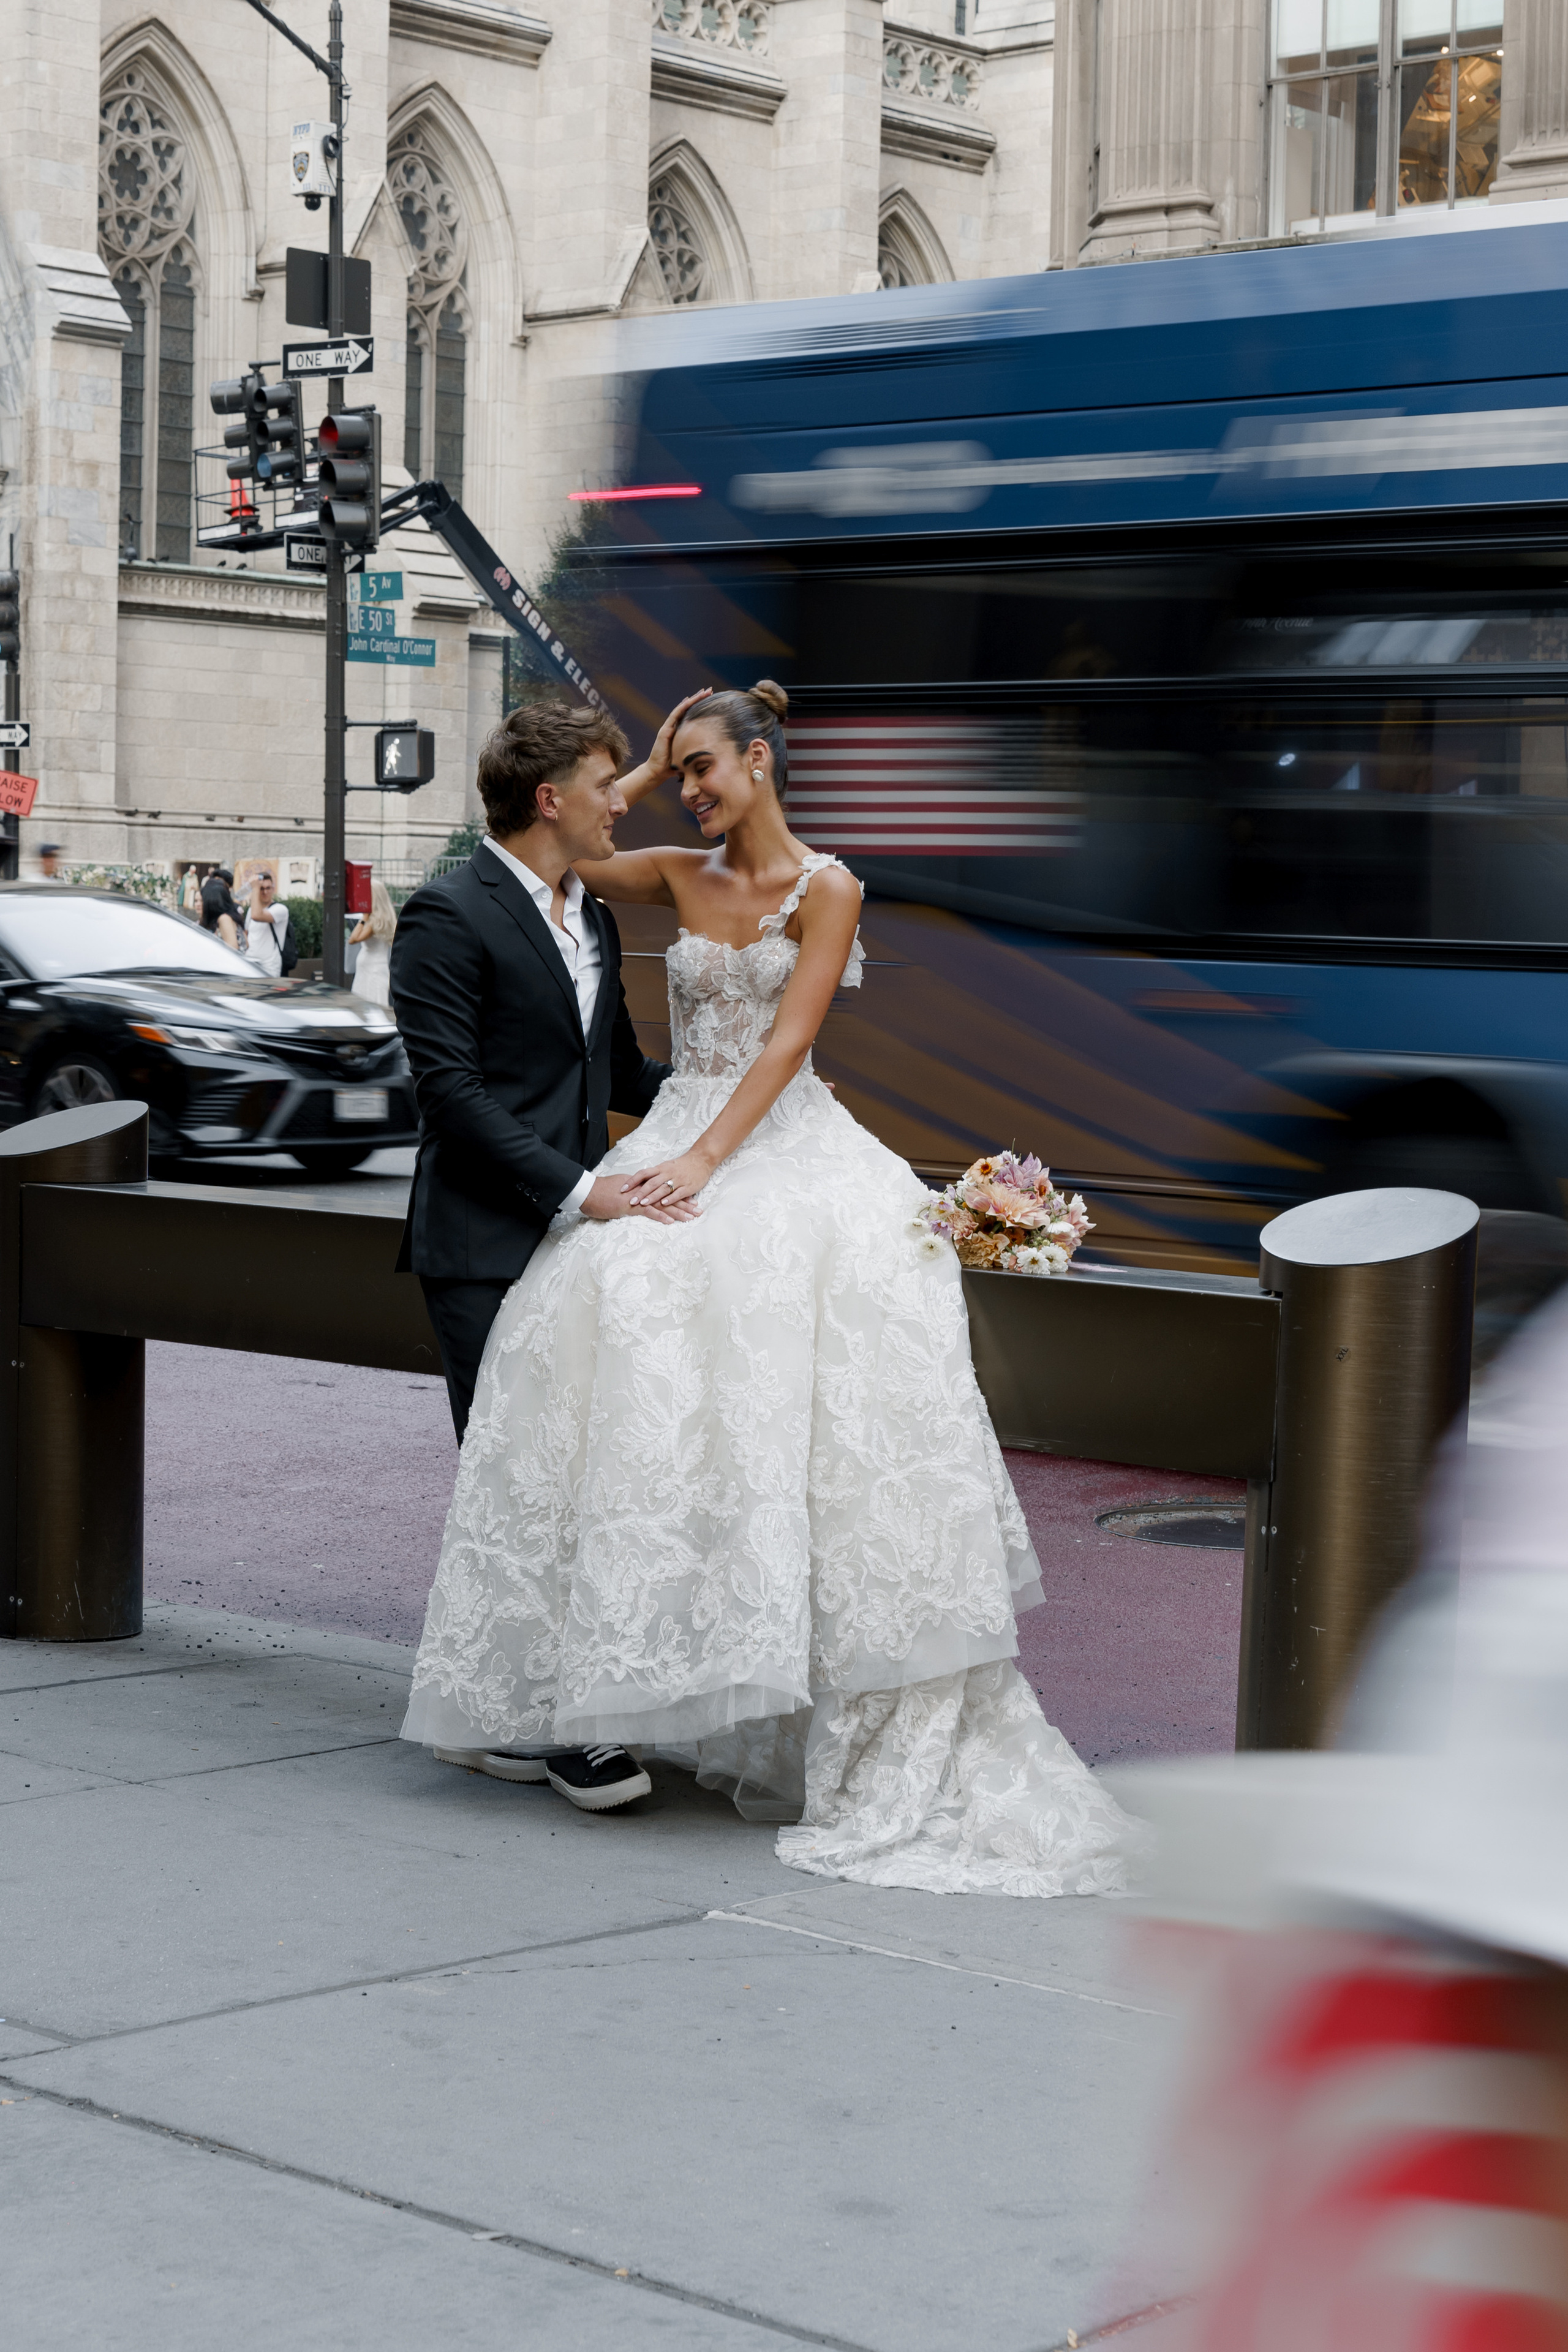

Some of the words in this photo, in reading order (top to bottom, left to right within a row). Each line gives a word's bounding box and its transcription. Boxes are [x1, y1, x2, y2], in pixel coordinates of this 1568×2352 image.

[296, 353, 322, 368] ONE
[334, 350, 360, 364] WAY
[298, 546, 320, 562] ONE
[369, 576, 377, 598] 5
[382, 576, 391, 589] Av
[359, 609, 365, 630] E
[369, 610, 382, 632] 50
[385, 612, 393, 625] St
[512, 589, 551, 642] SIGN
[551, 640, 564, 662] &
[349, 636, 368, 651] John
[370, 637, 401, 654] Cardinal
[402, 639, 432, 655] O'Connor
[386, 654, 396, 663] Way
[7, 731, 23, 740] WAY
[1336, 1348, 1349, 1362] XXL
